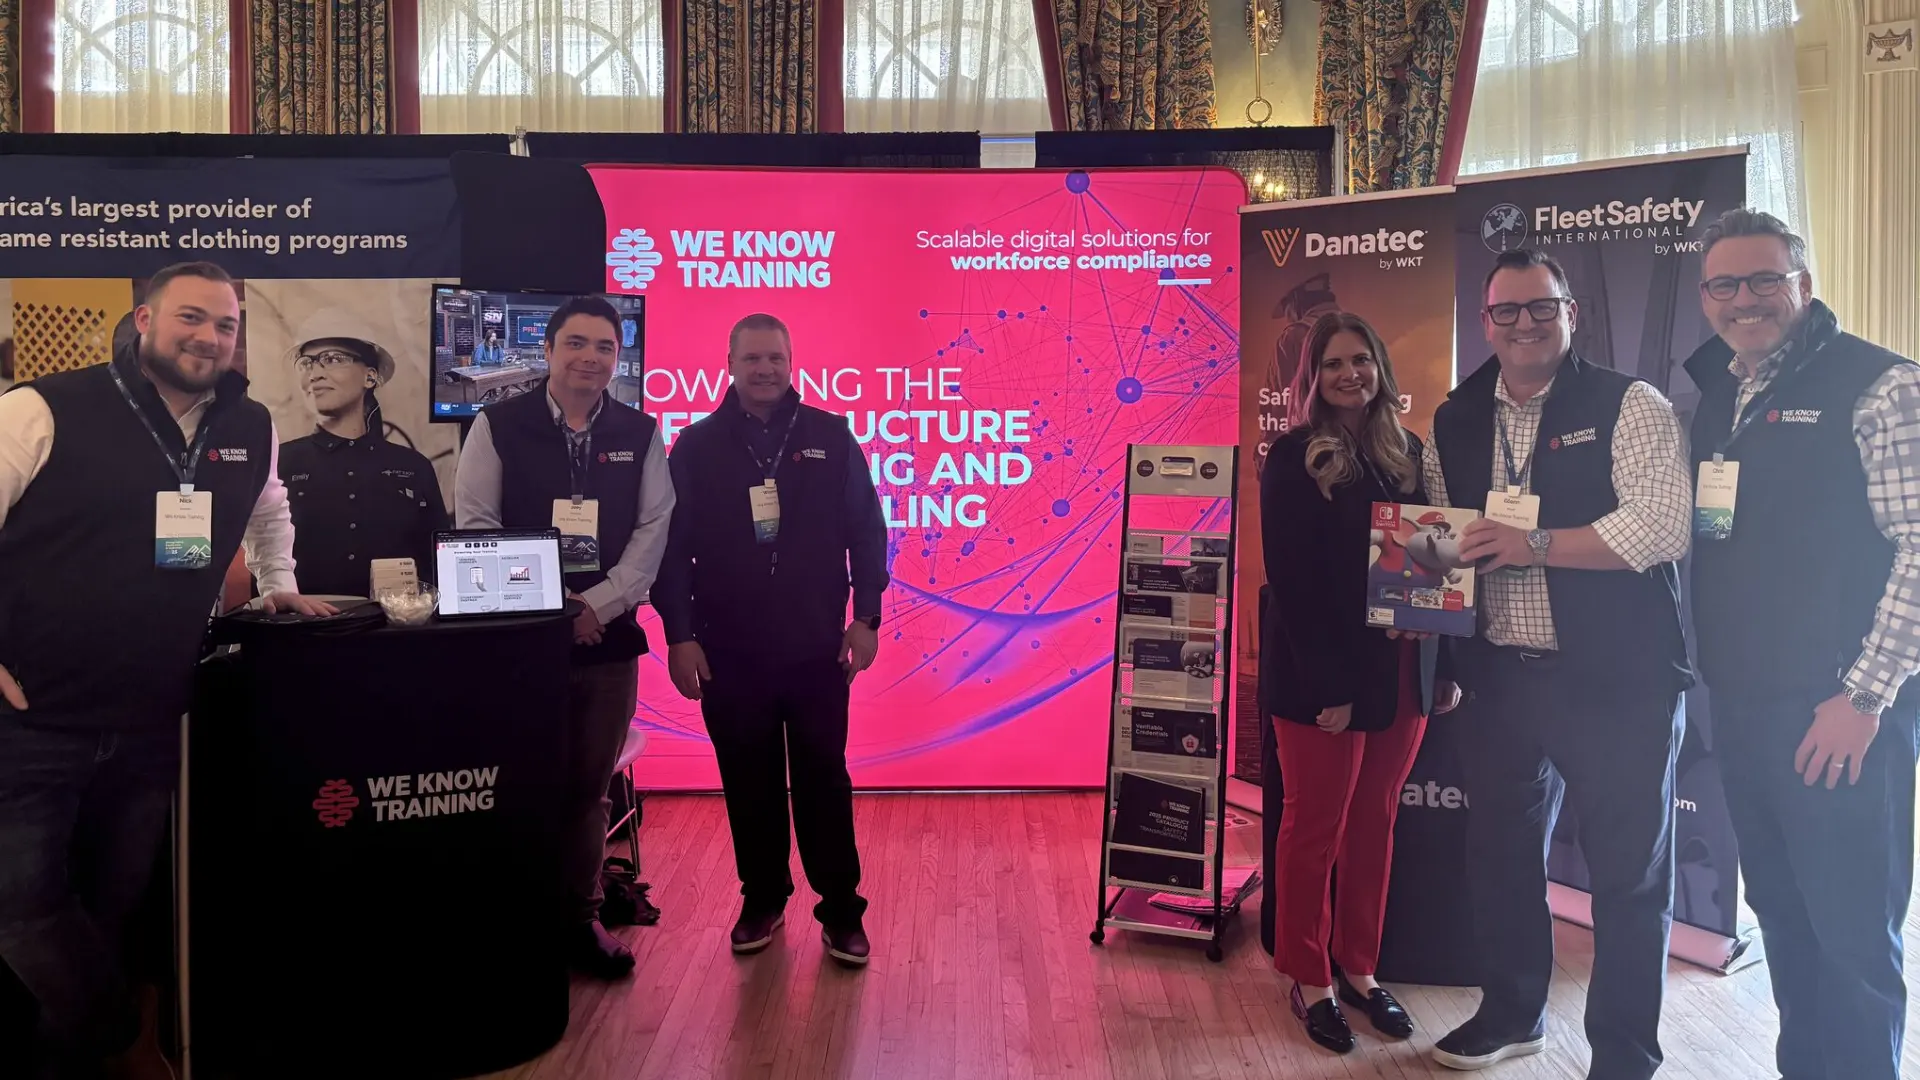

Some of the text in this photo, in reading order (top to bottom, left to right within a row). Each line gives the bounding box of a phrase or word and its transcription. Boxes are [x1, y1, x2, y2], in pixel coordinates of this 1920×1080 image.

[71, 195, 160, 223] largest
[168, 198, 278, 224] provider
[285, 197, 313, 219] of
[1535, 197, 1705, 231] FleetSafety
[0, 227, 408, 255] ame resistant clothing programs
[670, 230, 836, 258] WE KNOW
[916, 228, 1212, 252] Scalable digital solutions for
[1305, 227, 1426, 258] Danatec
[1536, 225, 1683, 245] INTERNATIONAL
[951, 249, 1212, 272] workforce compliance
[1655, 243, 1671, 256] by
[677, 261, 831, 288] TRAINING
[1379, 256, 1424, 270] by WKT
[876, 368, 963, 400] THE
[1781, 415, 1817, 423] TRAINING
[1782, 408, 1821, 418] WE KNOW
[1561, 427, 1596, 441] WE KNOW
[1563, 434, 1596, 447] TRAINING
[291, 473, 310, 482] Emily
[928, 452, 1033, 485] AND
[1135, 723, 1164, 732] Verifiable
[1135, 729, 1169, 738] Credentials
[367, 766, 499, 799] WE KNOW
[371, 789, 495, 822] TRAINING
